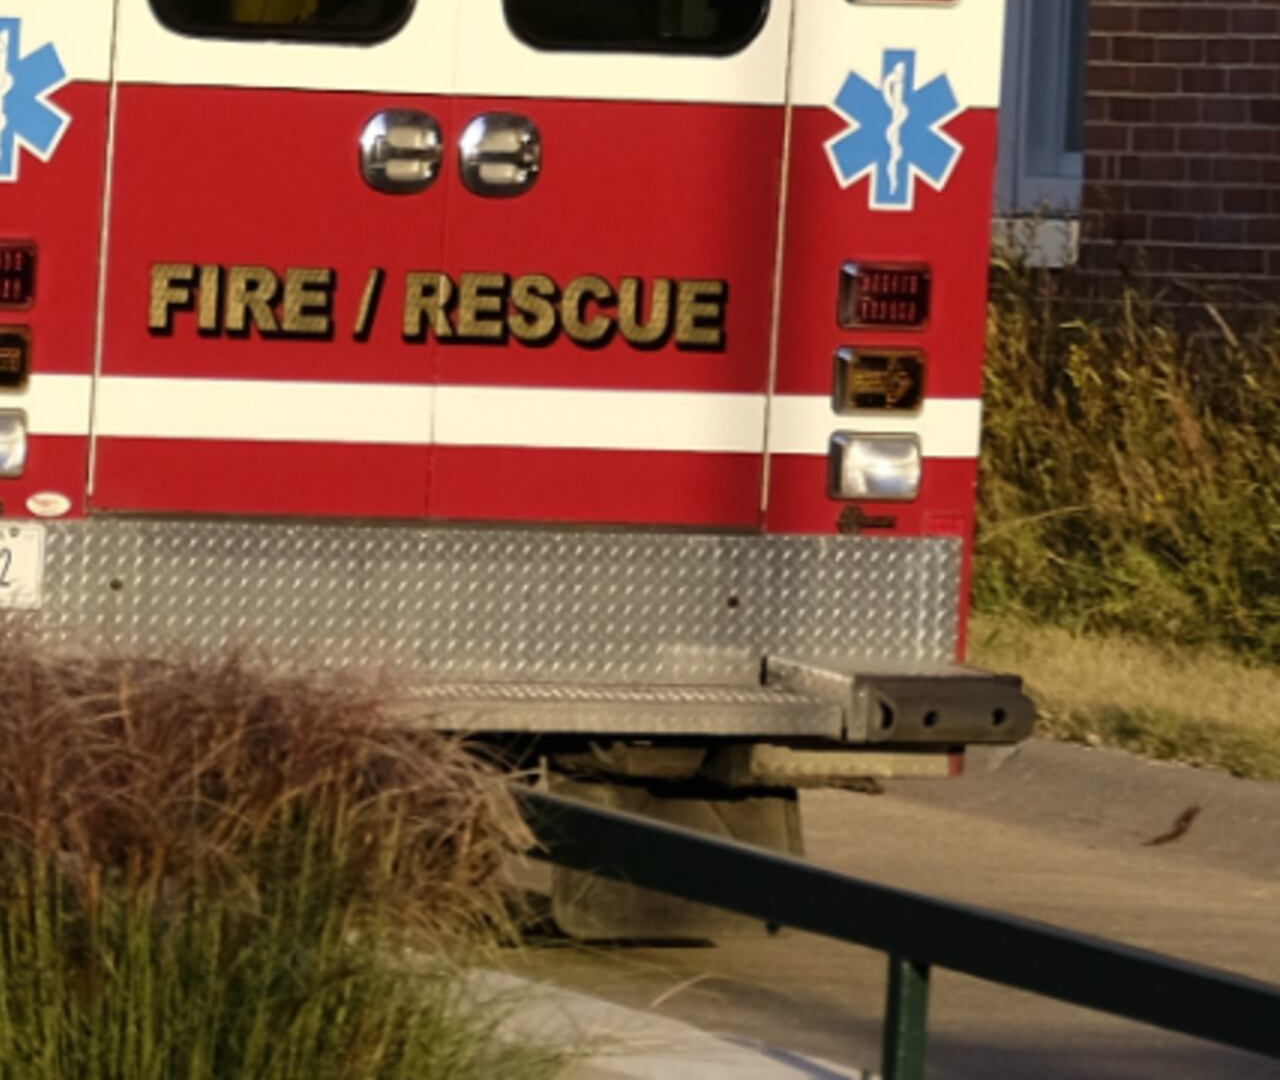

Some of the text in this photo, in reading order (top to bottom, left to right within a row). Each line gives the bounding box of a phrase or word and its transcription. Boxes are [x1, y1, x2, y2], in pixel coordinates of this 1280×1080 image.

[148, 263, 729, 352] FIRE / RESCUE
